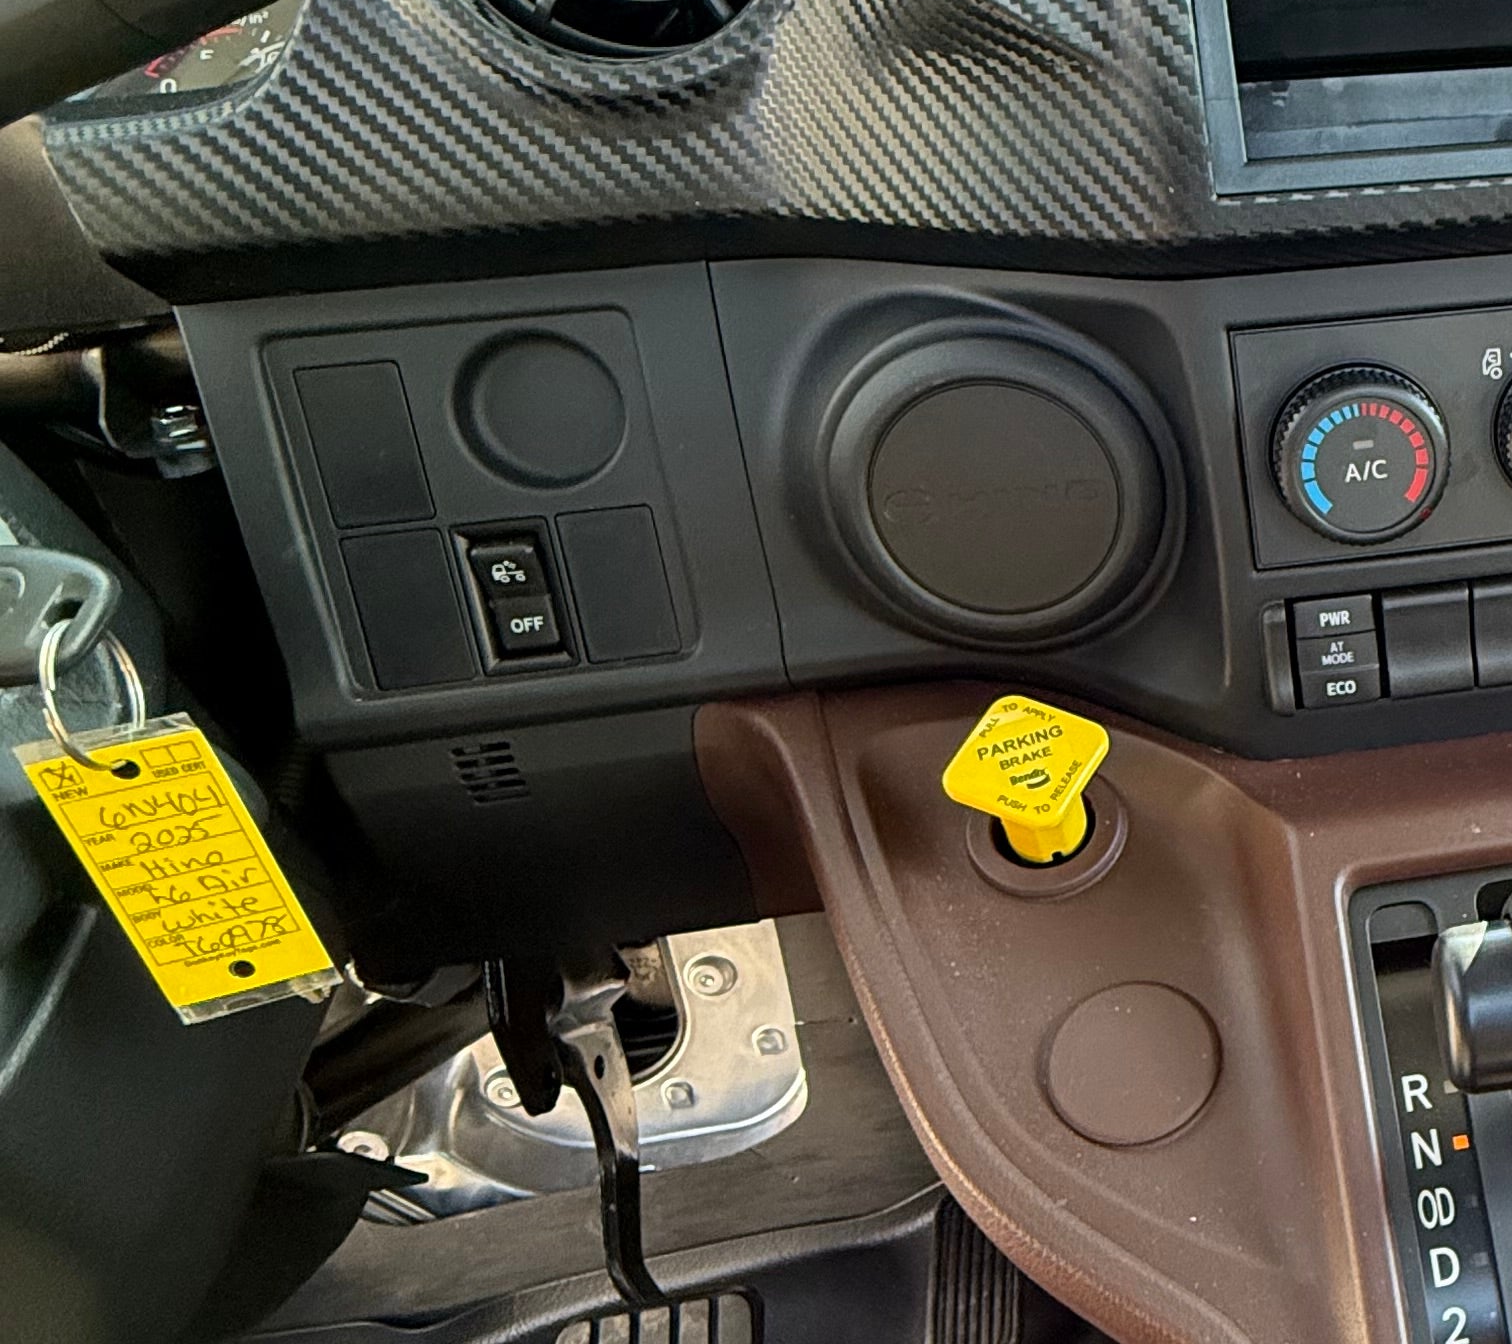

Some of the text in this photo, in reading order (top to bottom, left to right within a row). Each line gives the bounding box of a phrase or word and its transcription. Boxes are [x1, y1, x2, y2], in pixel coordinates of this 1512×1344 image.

[1345, 459, 1388, 483] A/C
[510, 616, 544, 634] OFF
[1319, 611, 1351, 628] PWR
[1322, 652, 1354, 665] MODE
[1330, 642, 1344, 653] AT
[1326, 680, 1357, 696] ECO
[978, 702, 1057, 738] PULL TO APPLY
[977, 725, 1064, 761] PARKING
[152, 760, 207, 779] USED CERT
[999, 746, 1053, 771] BRAKE
[52, 786, 89, 802] NEW
[996, 759, 1082, 815] PUSH TO RELEASE
[84, 833, 116, 846] YEAR
[130, 813, 223, 853] 2025
[100, 858, 134, 872] MAKE
[140, 850, 223, 881] Hino
[148, 934, 185, 948] COLOR
[1401, 1073, 1433, 1112] R
[1411, 1128, 1443, 1170] N
[1418, 1187, 1455, 1229] OD
[1429, 1247, 1460, 1288] D
